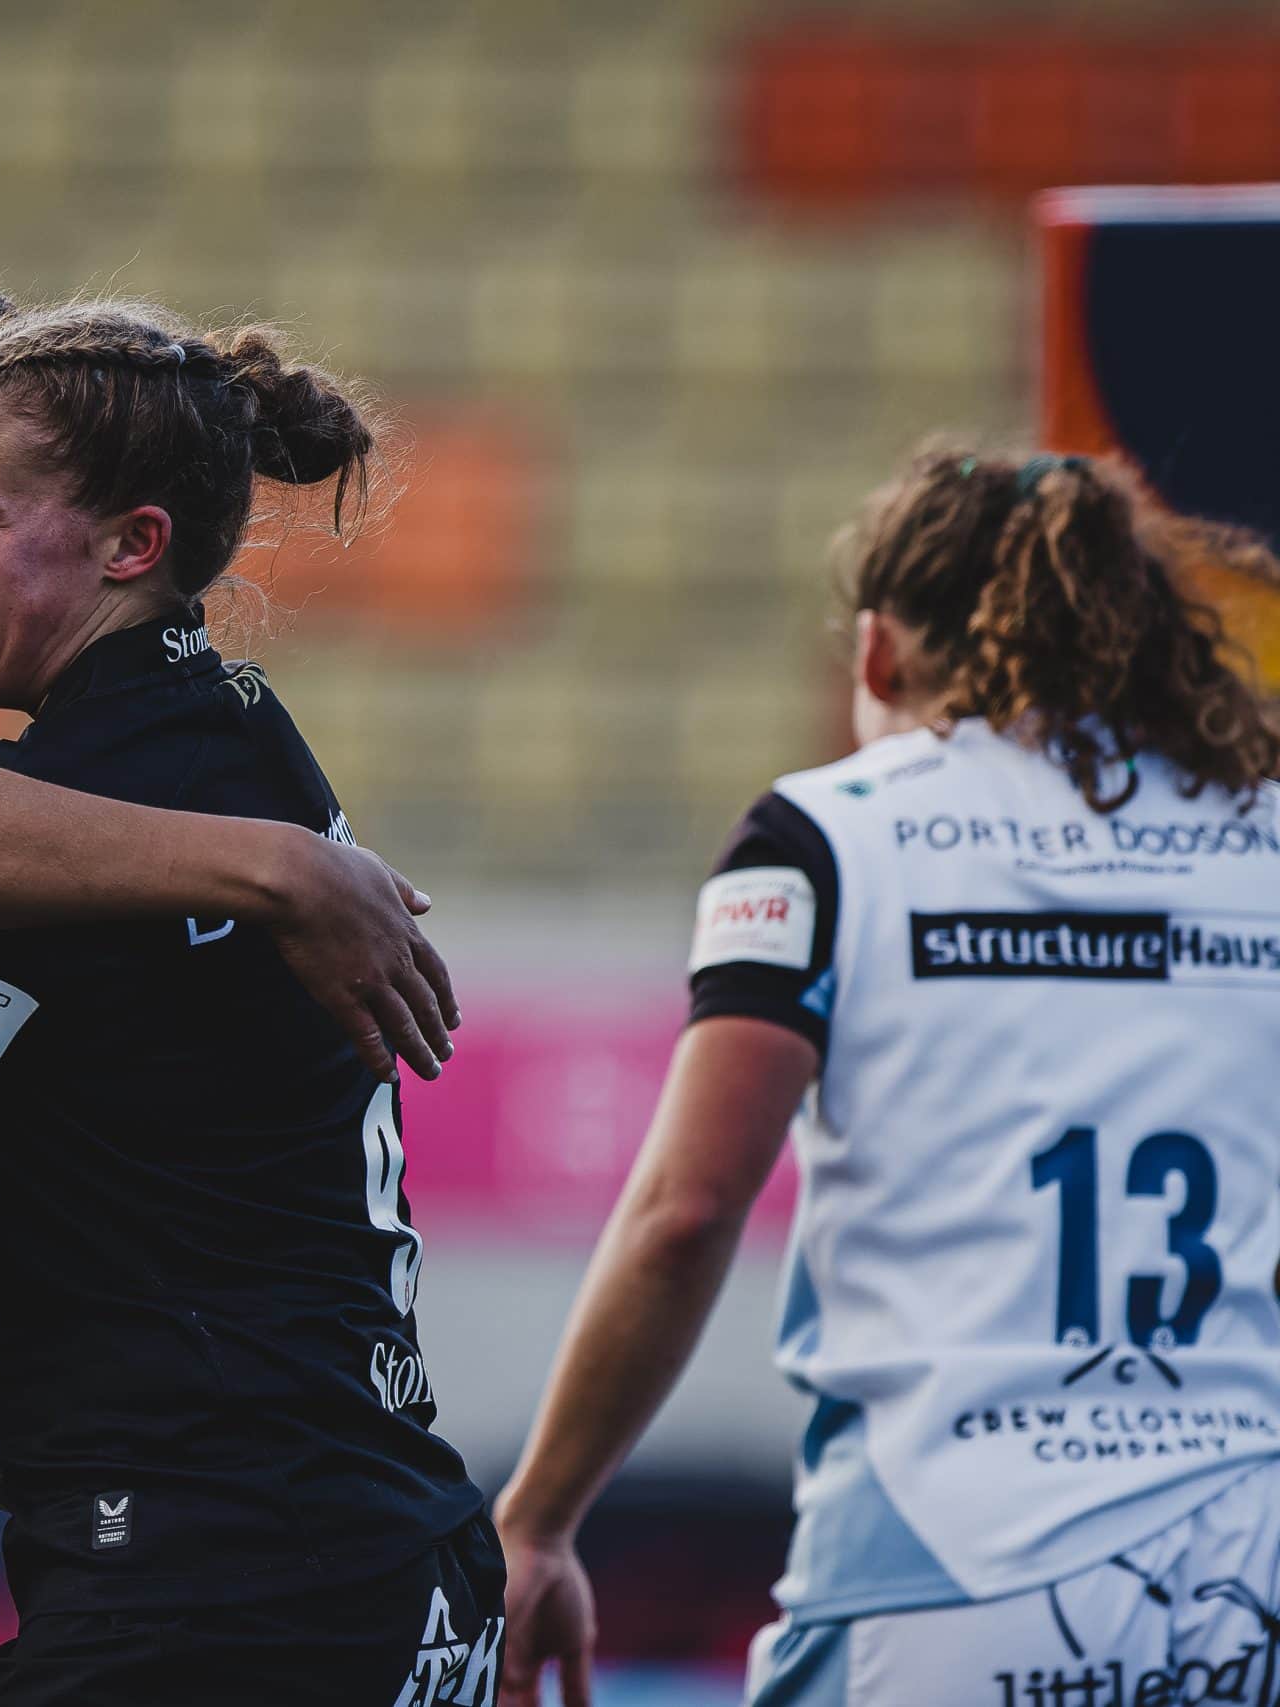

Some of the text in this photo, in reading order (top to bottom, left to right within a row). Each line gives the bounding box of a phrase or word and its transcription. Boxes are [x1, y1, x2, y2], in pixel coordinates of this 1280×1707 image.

[894, 816, 1091, 855] PORTER
[1030, 1126, 1222, 1346] 13
[953, 1407, 1065, 1440] CREW
[1034, 1437, 1226, 1463] COMPANY
